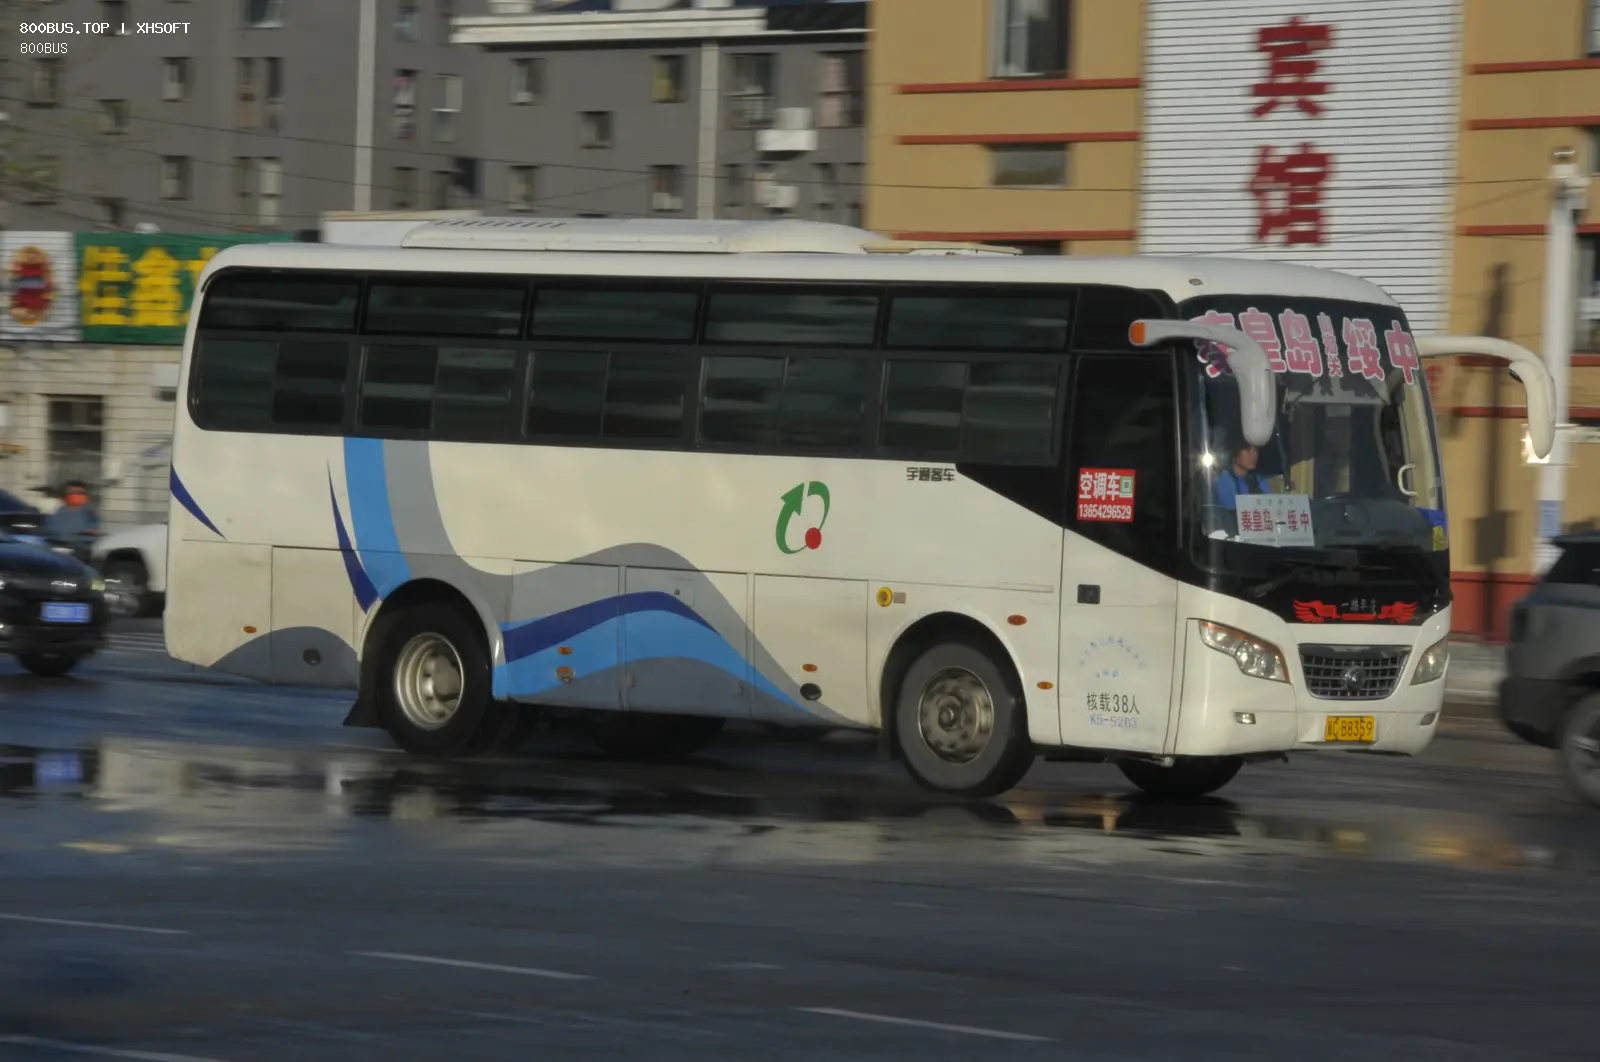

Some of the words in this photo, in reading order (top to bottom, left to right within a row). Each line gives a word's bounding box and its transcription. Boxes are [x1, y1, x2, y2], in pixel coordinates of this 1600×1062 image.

[1247, 15, 1336, 246] 宾馆
[906, 466, 956, 482] 宇通客车
[1079, 471, 1121, 501] 空调车
[1079, 503, 1132, 520] 13654296529
[1086, 691, 1141, 715] 核载38人
